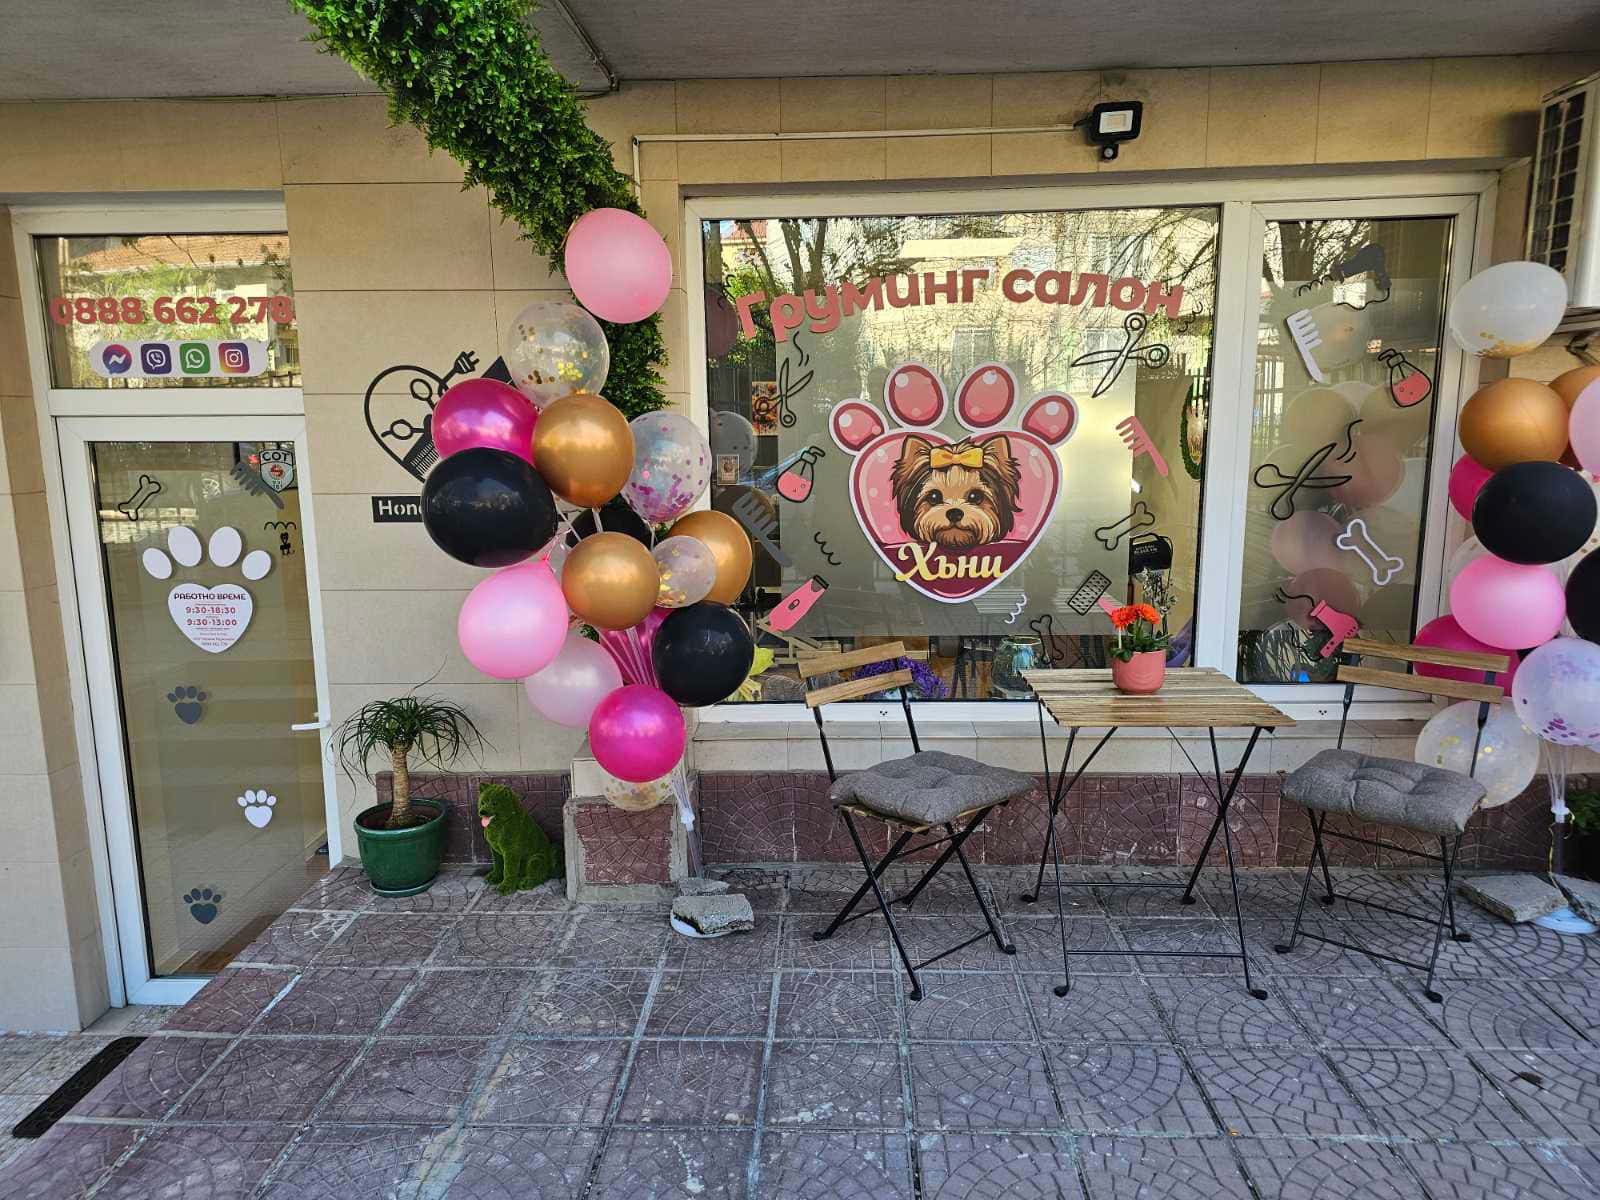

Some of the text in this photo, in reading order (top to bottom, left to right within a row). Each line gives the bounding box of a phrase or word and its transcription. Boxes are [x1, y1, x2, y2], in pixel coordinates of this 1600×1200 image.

[50, 296, 293, 325] 0888 662 278
[735, 268, 1184, 343] Груминг салон
[378, 500, 422, 515] Hon
[895, 541, 1003, 581] Хъни
